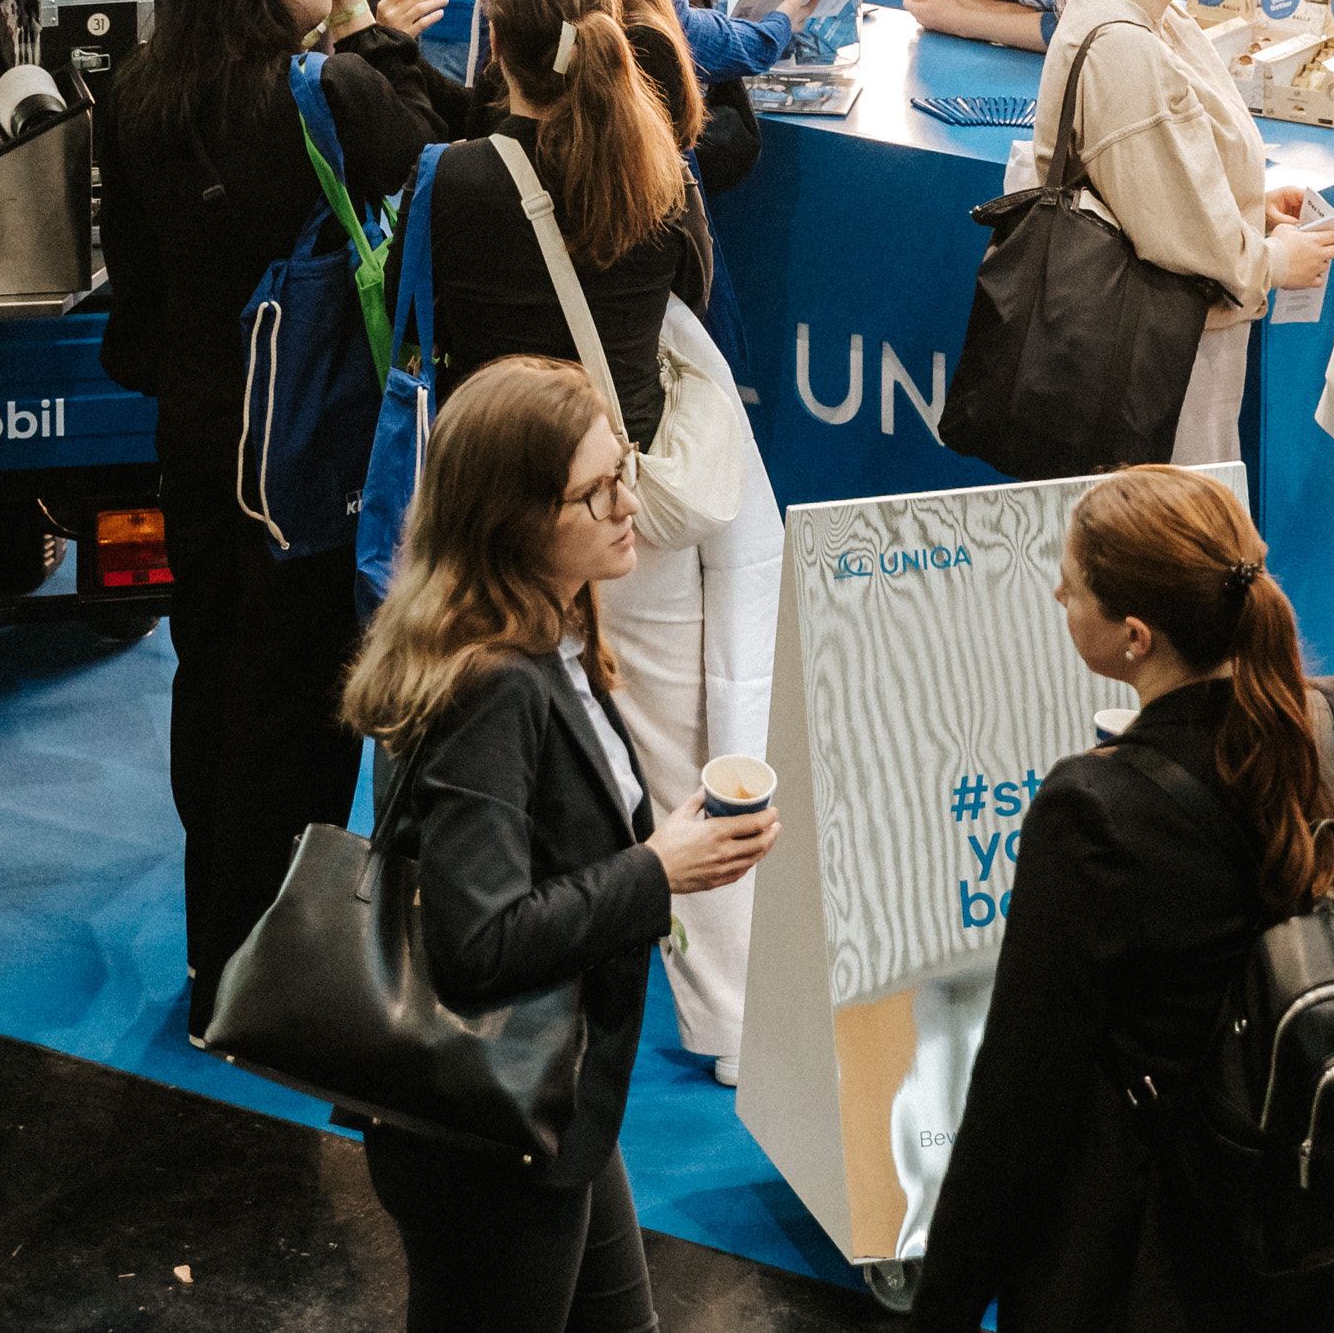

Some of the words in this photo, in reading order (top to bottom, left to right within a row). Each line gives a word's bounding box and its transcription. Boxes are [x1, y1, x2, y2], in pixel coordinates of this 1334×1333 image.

[93, 18, 105, 32] 31
[879, 545, 973, 576] UNIQA
[919, 1129, 959, 1148] Bew
